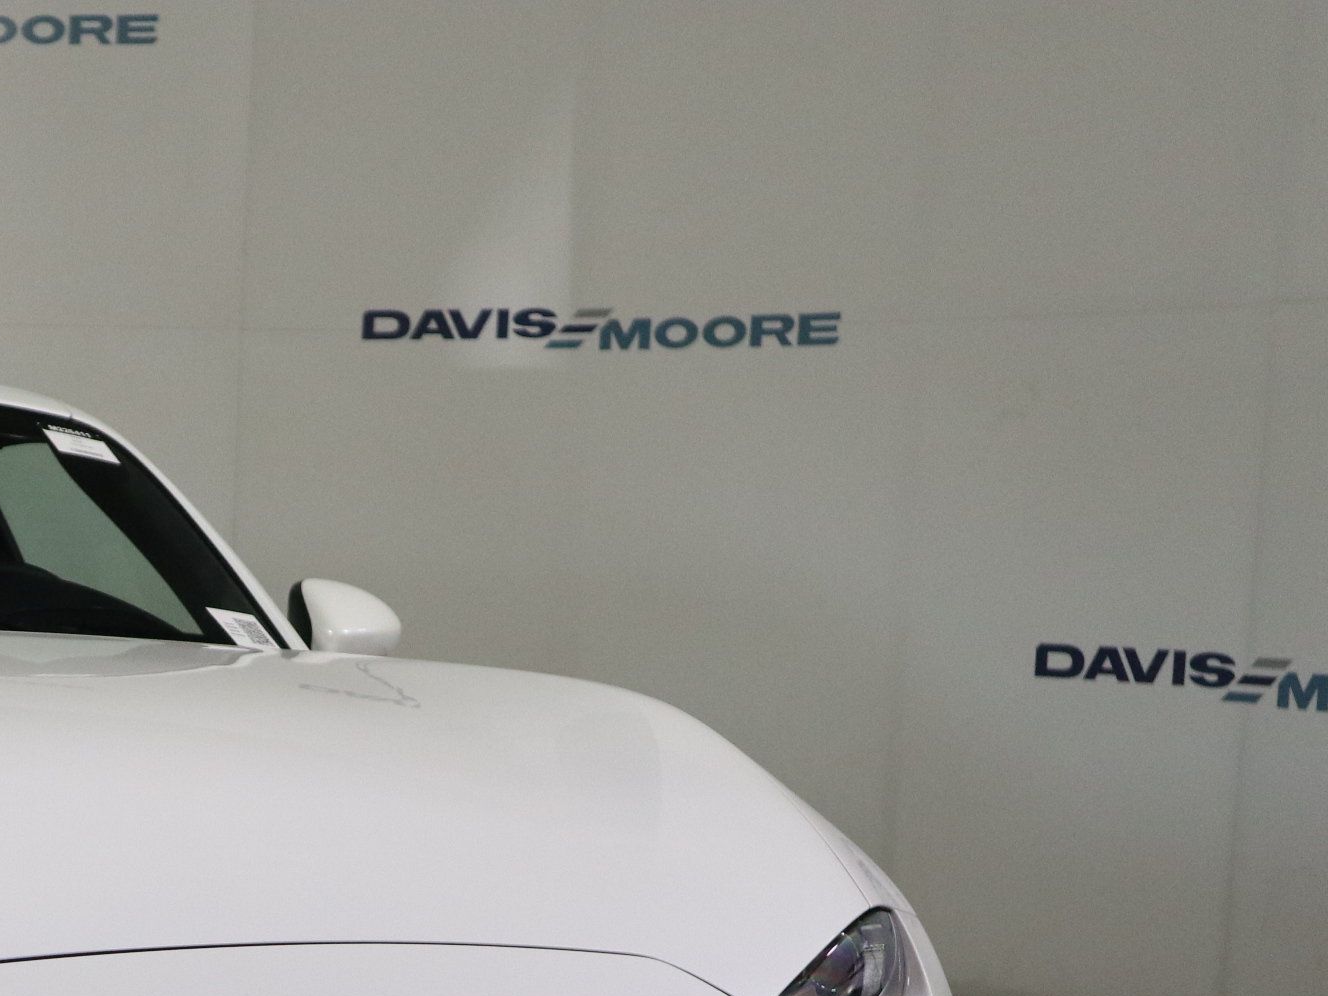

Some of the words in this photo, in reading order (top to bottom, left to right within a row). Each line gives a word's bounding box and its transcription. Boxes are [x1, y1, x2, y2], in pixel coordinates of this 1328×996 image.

[360, 307, 558, 341] DAVIS
[598, 313, 842, 352] MOORE
[1033, 643, 1237, 689] DAVIS
